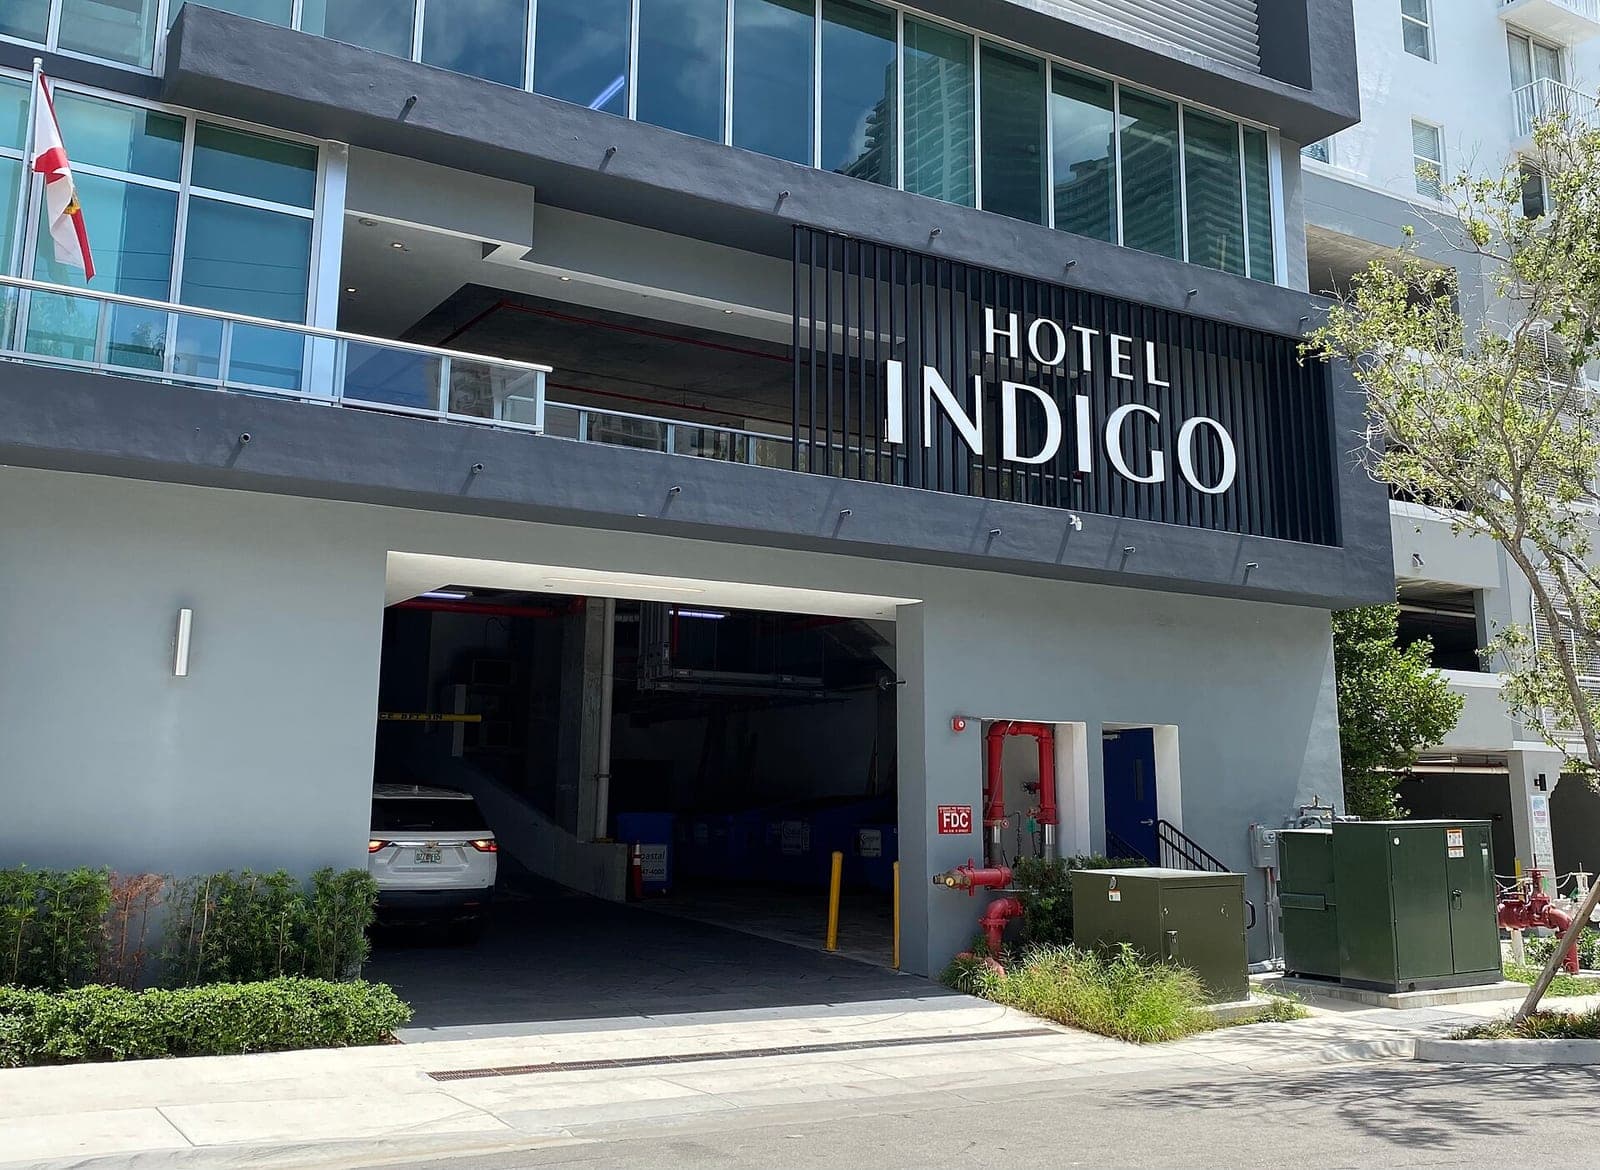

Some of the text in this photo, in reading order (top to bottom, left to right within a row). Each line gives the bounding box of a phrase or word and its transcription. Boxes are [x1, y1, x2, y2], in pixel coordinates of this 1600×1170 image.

[984, 306, 1170, 388] HOTEL
[886, 359, 1237, 495] INDIGO
[943, 812, 968, 828] FDC
[640, 850, 665, 859] oastal
